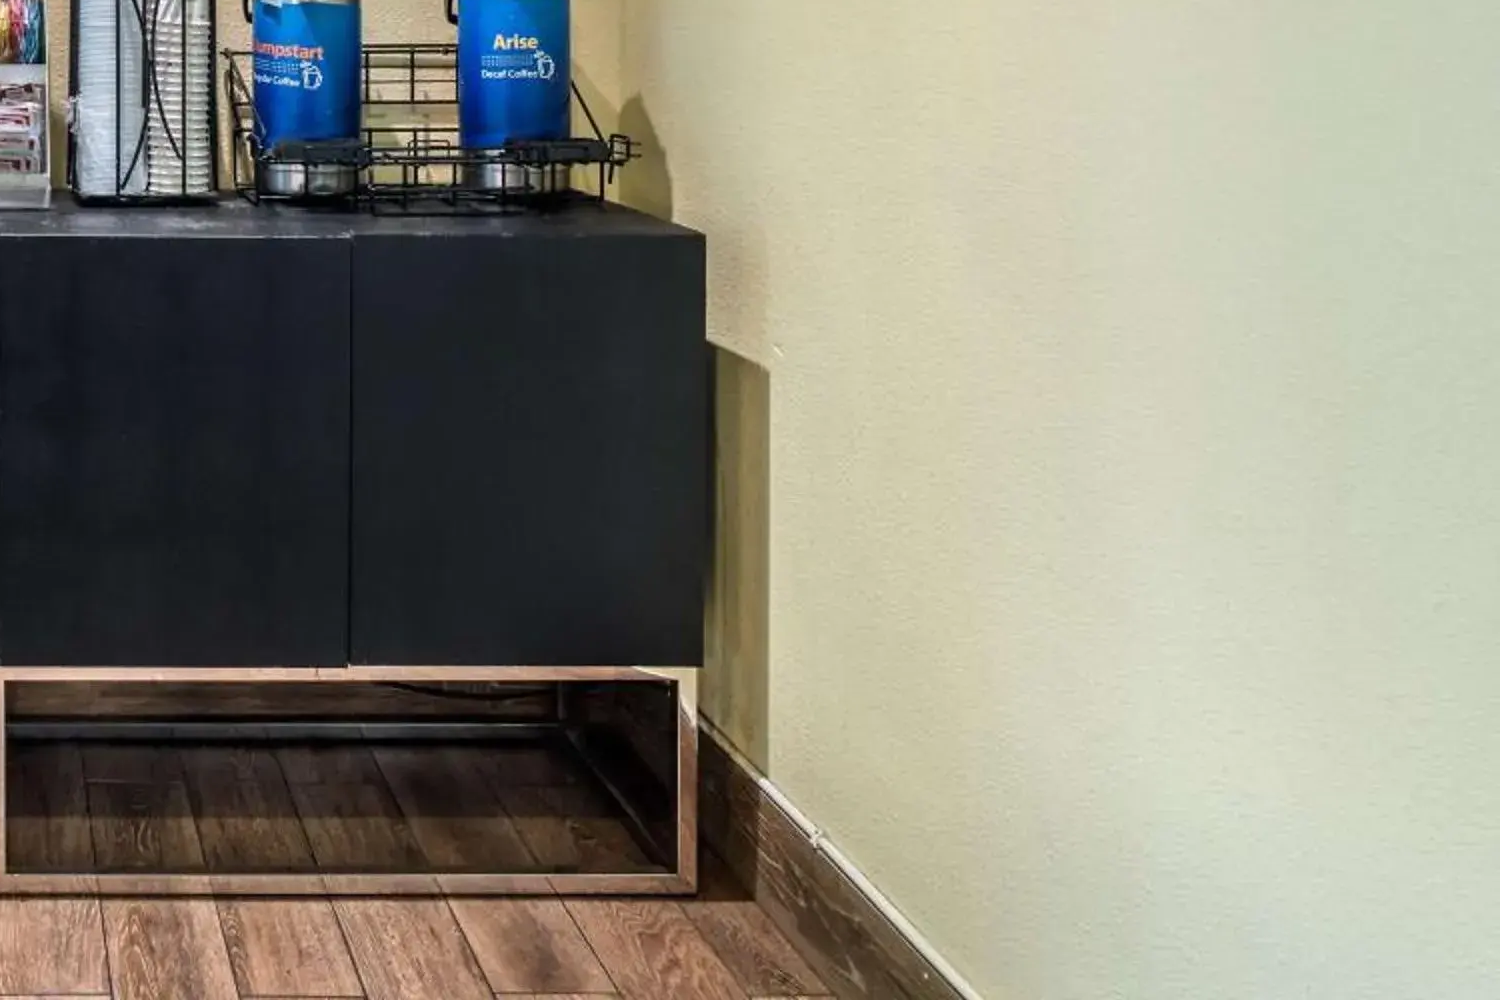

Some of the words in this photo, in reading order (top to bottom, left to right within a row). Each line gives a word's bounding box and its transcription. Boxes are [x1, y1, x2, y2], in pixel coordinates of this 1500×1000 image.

[493, 33, 539, 50] Arise
[481, 69, 507, 79] Decaf
[508, 69, 538, 79] Coffee
[273, 76, 300, 87] Coffee
